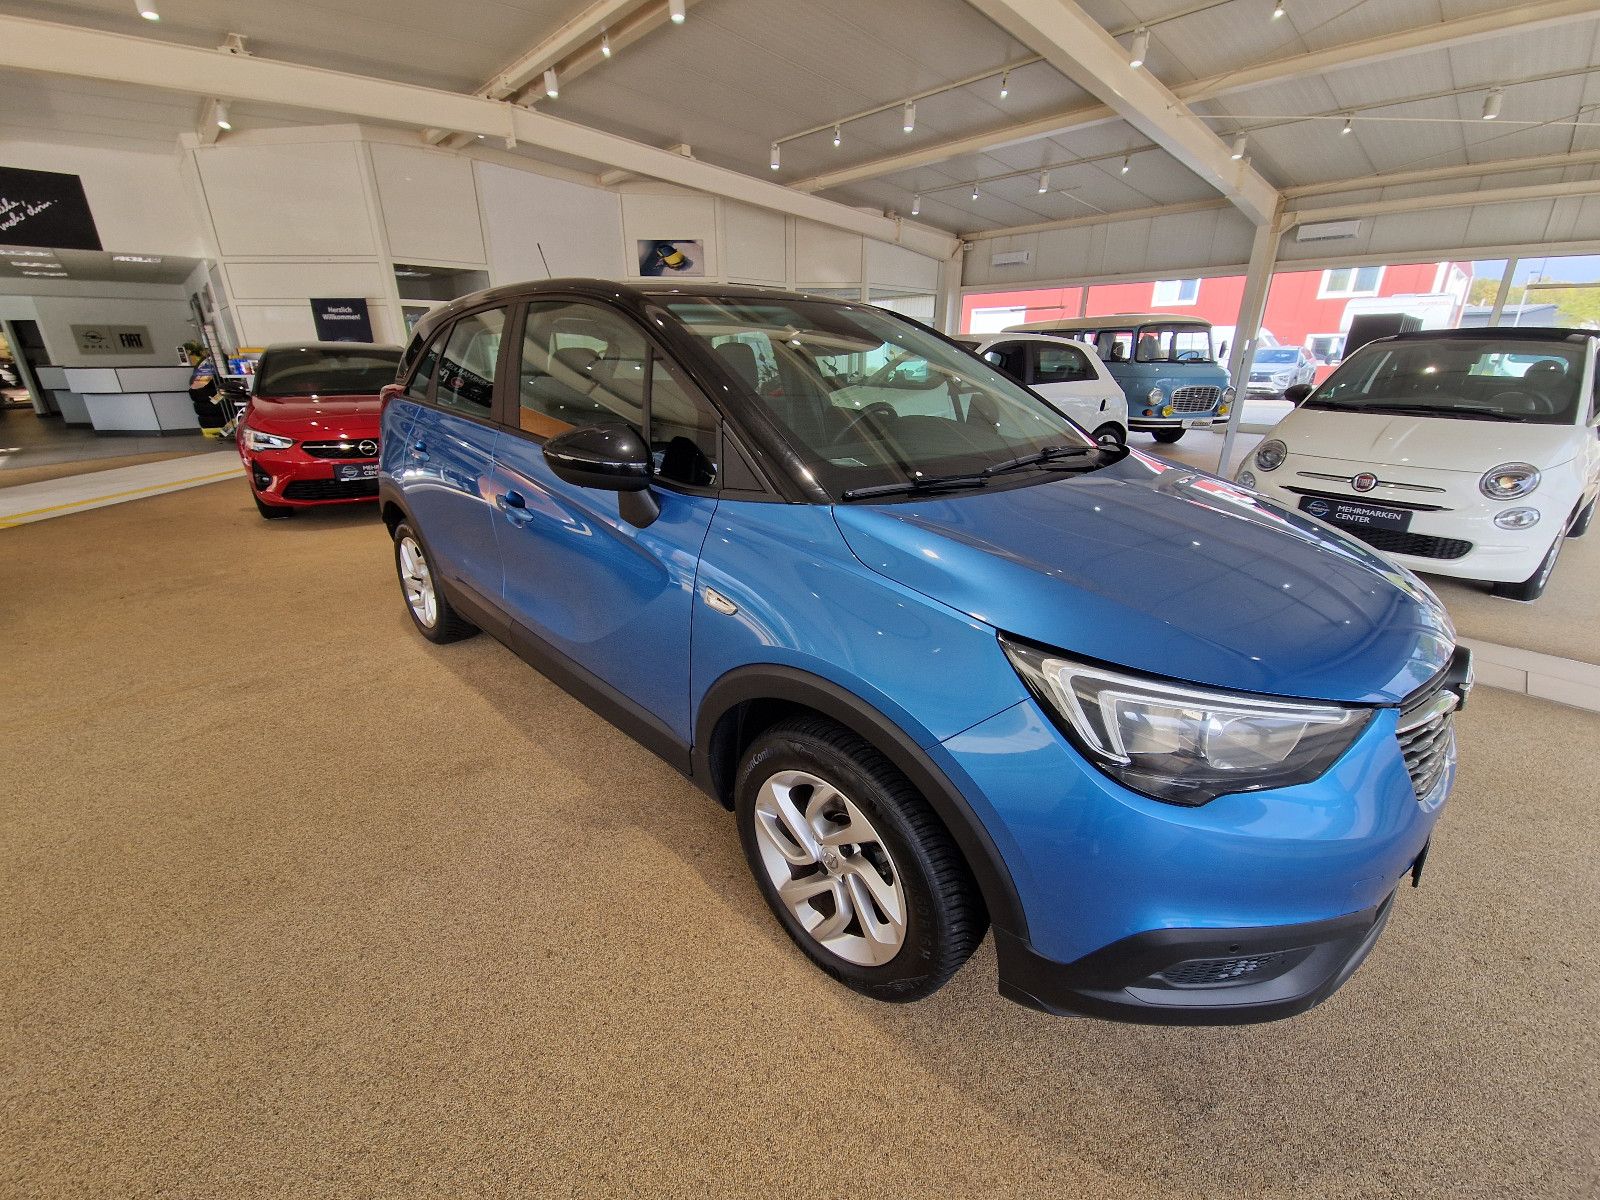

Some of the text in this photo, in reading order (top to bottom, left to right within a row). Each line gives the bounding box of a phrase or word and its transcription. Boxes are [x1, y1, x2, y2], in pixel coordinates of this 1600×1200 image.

[119, 333, 144, 348] FIAT
[1335, 512, 1370, 524] CENTER
[1337, 505, 1402, 520] MEHRMARKEN
